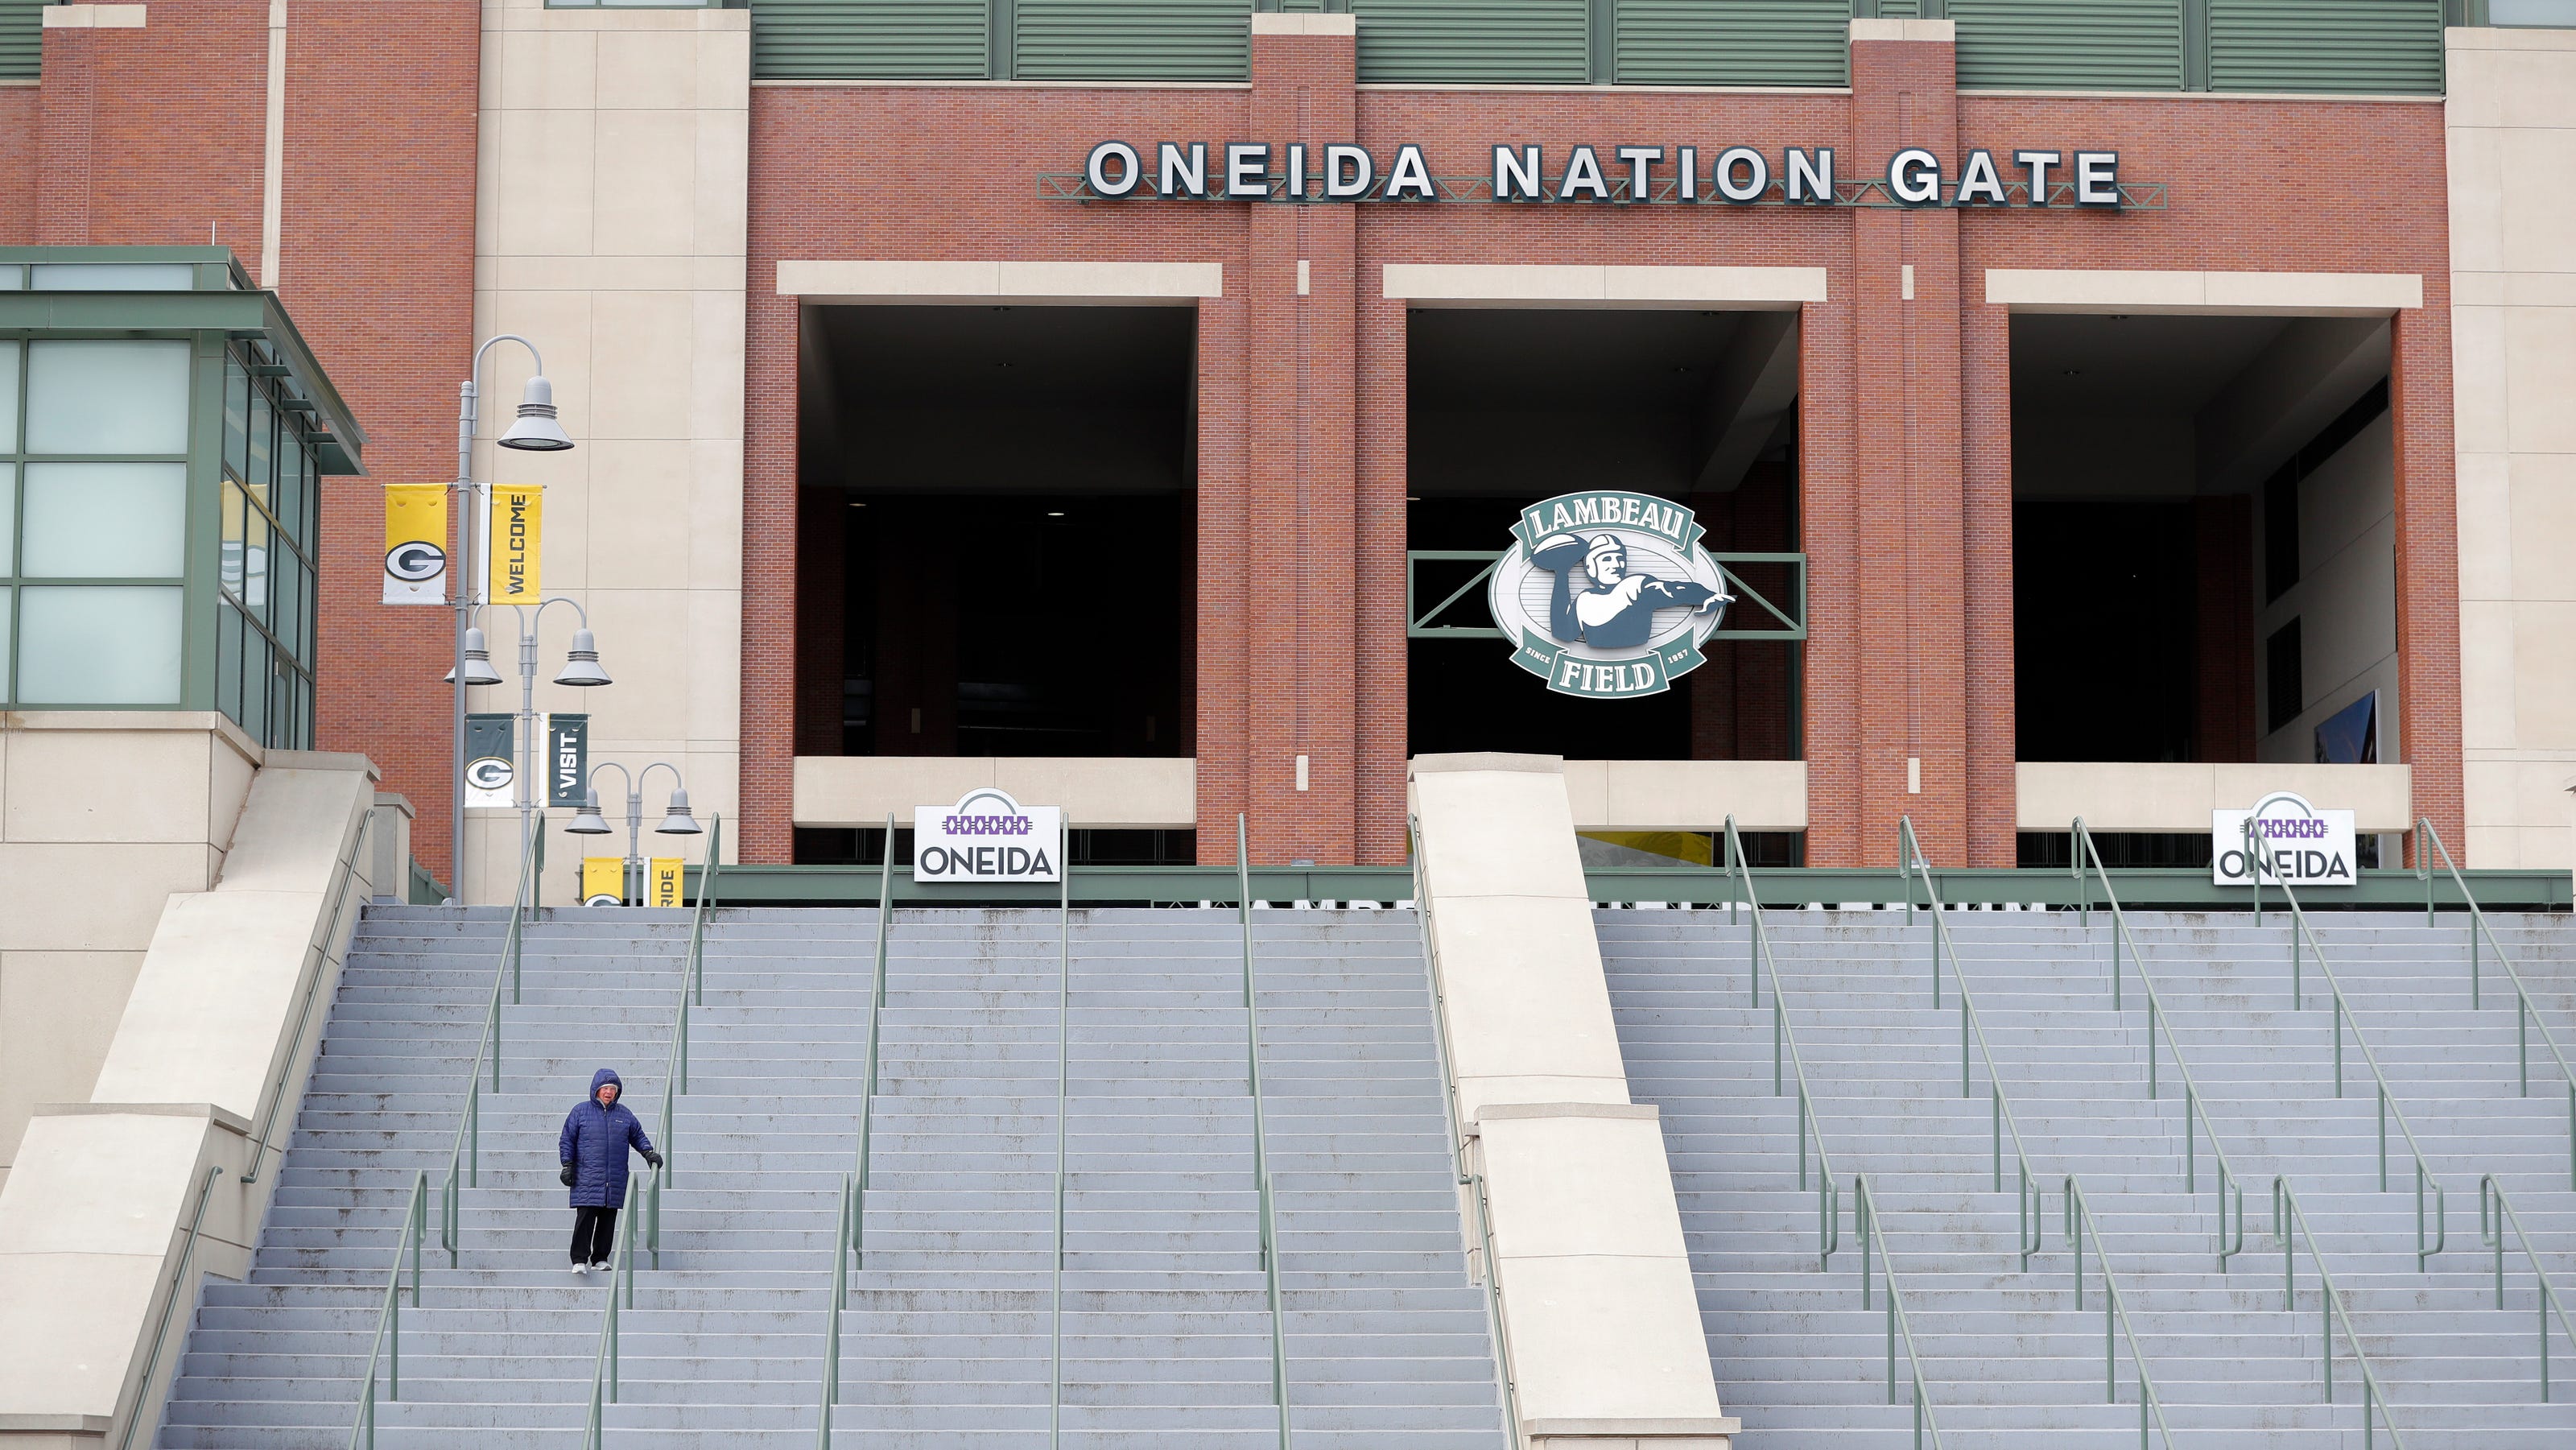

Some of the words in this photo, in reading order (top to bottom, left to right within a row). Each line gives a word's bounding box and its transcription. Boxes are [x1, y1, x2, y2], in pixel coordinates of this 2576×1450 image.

[1086, 141, 1437, 200] ONEIDA
[1493, 146, 1833, 204] NATION
[1889, 147, 2120, 206] GATE
[1530, 497, 1685, 539] LAMBEAU
[509, 494, 526, 595] WELCOME
[1525, 647, 1550, 663] SINCE
[1668, 649, 1689, 663] 1957
[1558, 660, 1655, 692] FIELD
[559, 733, 576, 789] VISIT
[920, 846, 1054, 875] ONEIDA
